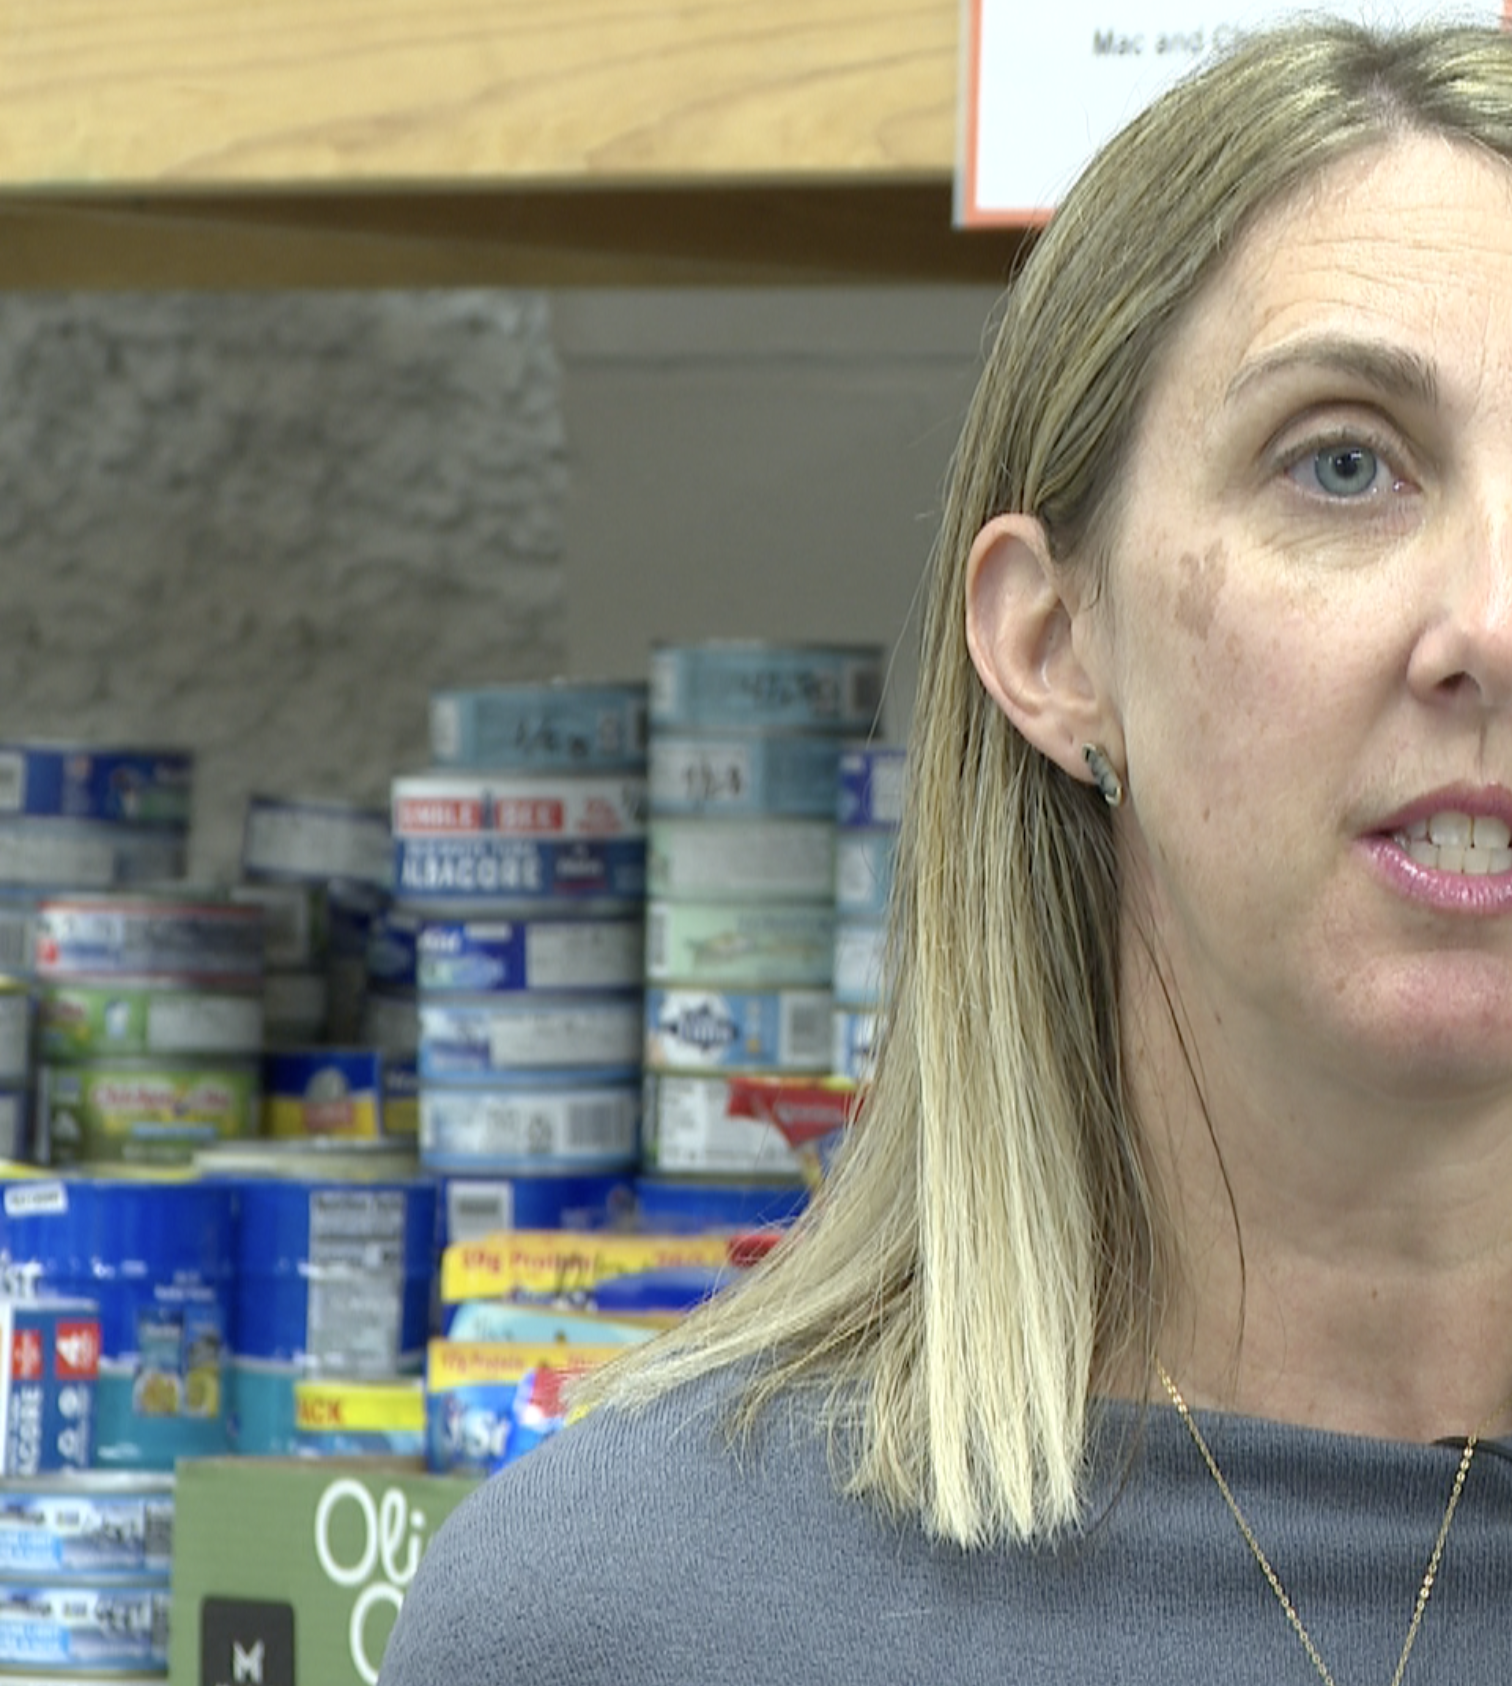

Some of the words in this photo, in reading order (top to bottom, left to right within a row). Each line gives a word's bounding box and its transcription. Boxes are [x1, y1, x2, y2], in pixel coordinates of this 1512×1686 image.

[1093, 27, 1143, 55] Mac
[1155, 24, 1203, 55] and
[401, 855, 544, 891] ALBACORE
